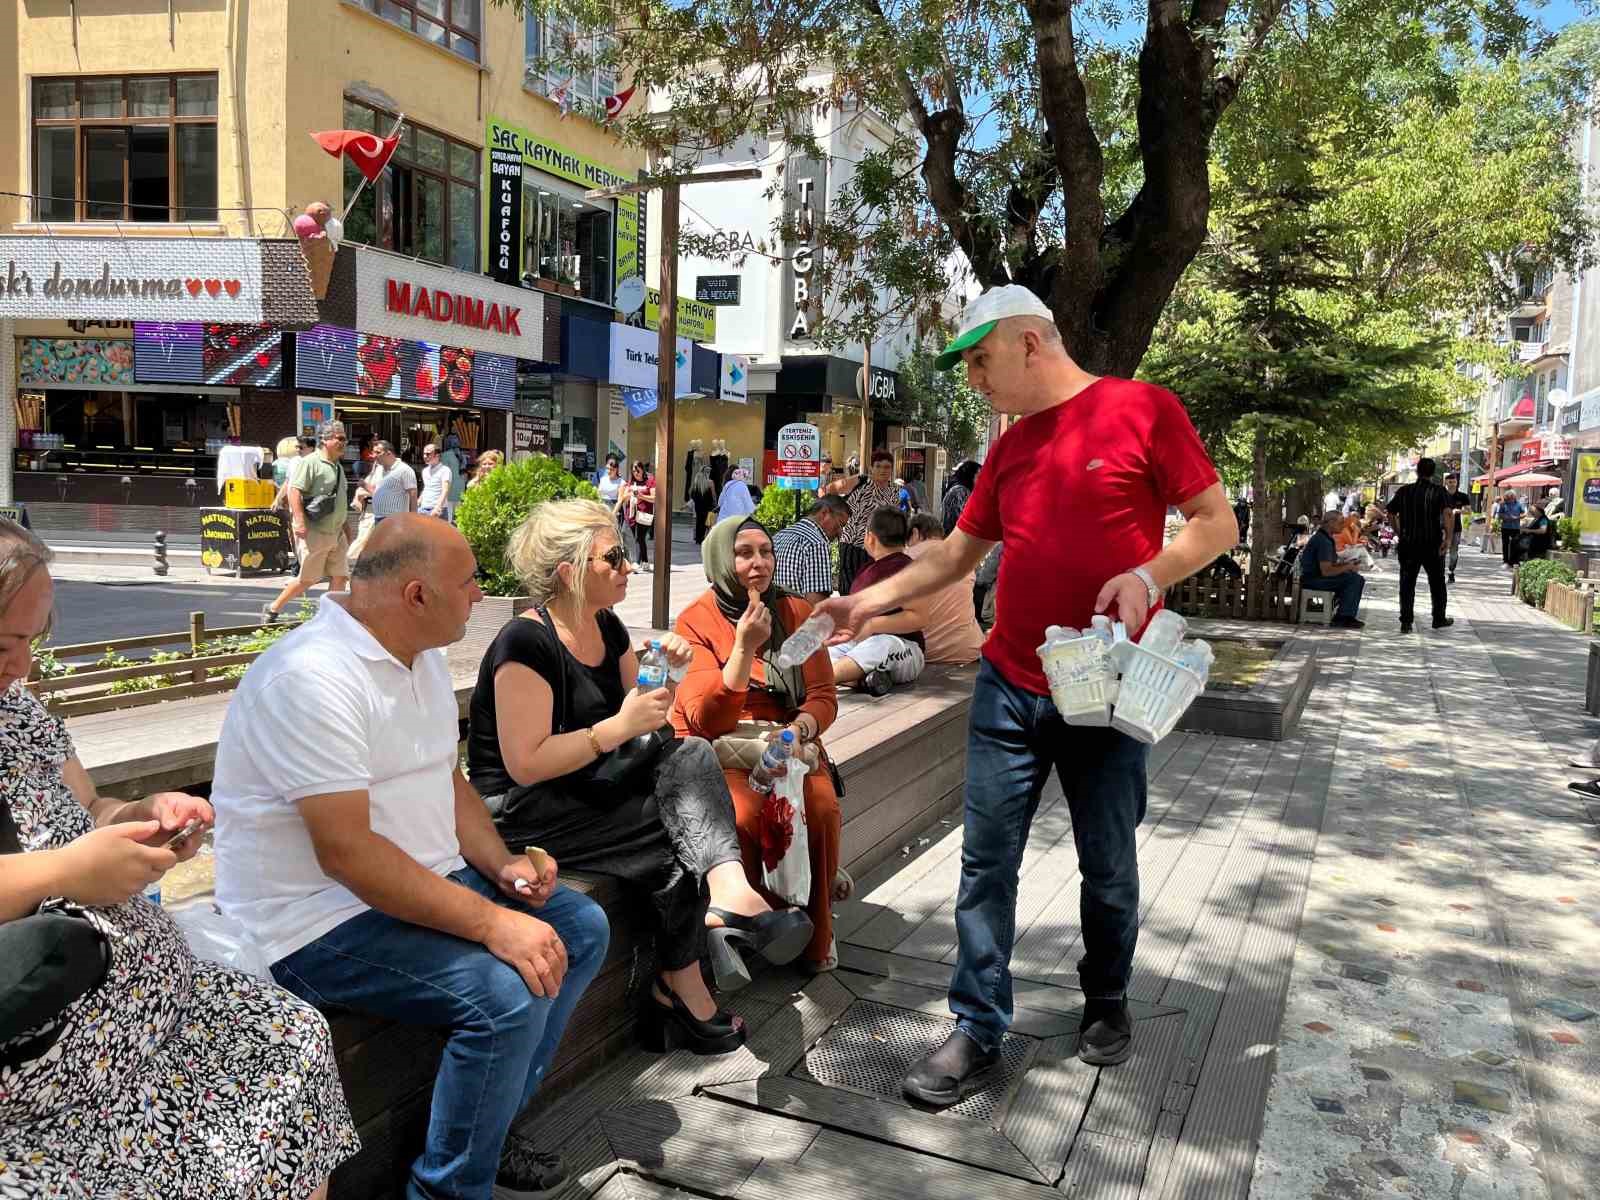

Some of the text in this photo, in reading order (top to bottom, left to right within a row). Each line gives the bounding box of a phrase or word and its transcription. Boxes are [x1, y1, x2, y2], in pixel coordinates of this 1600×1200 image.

[492, 162, 521, 176] BAYAN
[524, 138, 581, 176] KAYNAK
[43, 261, 184, 299] dondurma
[386, 279, 522, 337] MADIMAK
[685, 303, 714, 321] HAVVA
[625, 349, 643, 363] Türk
